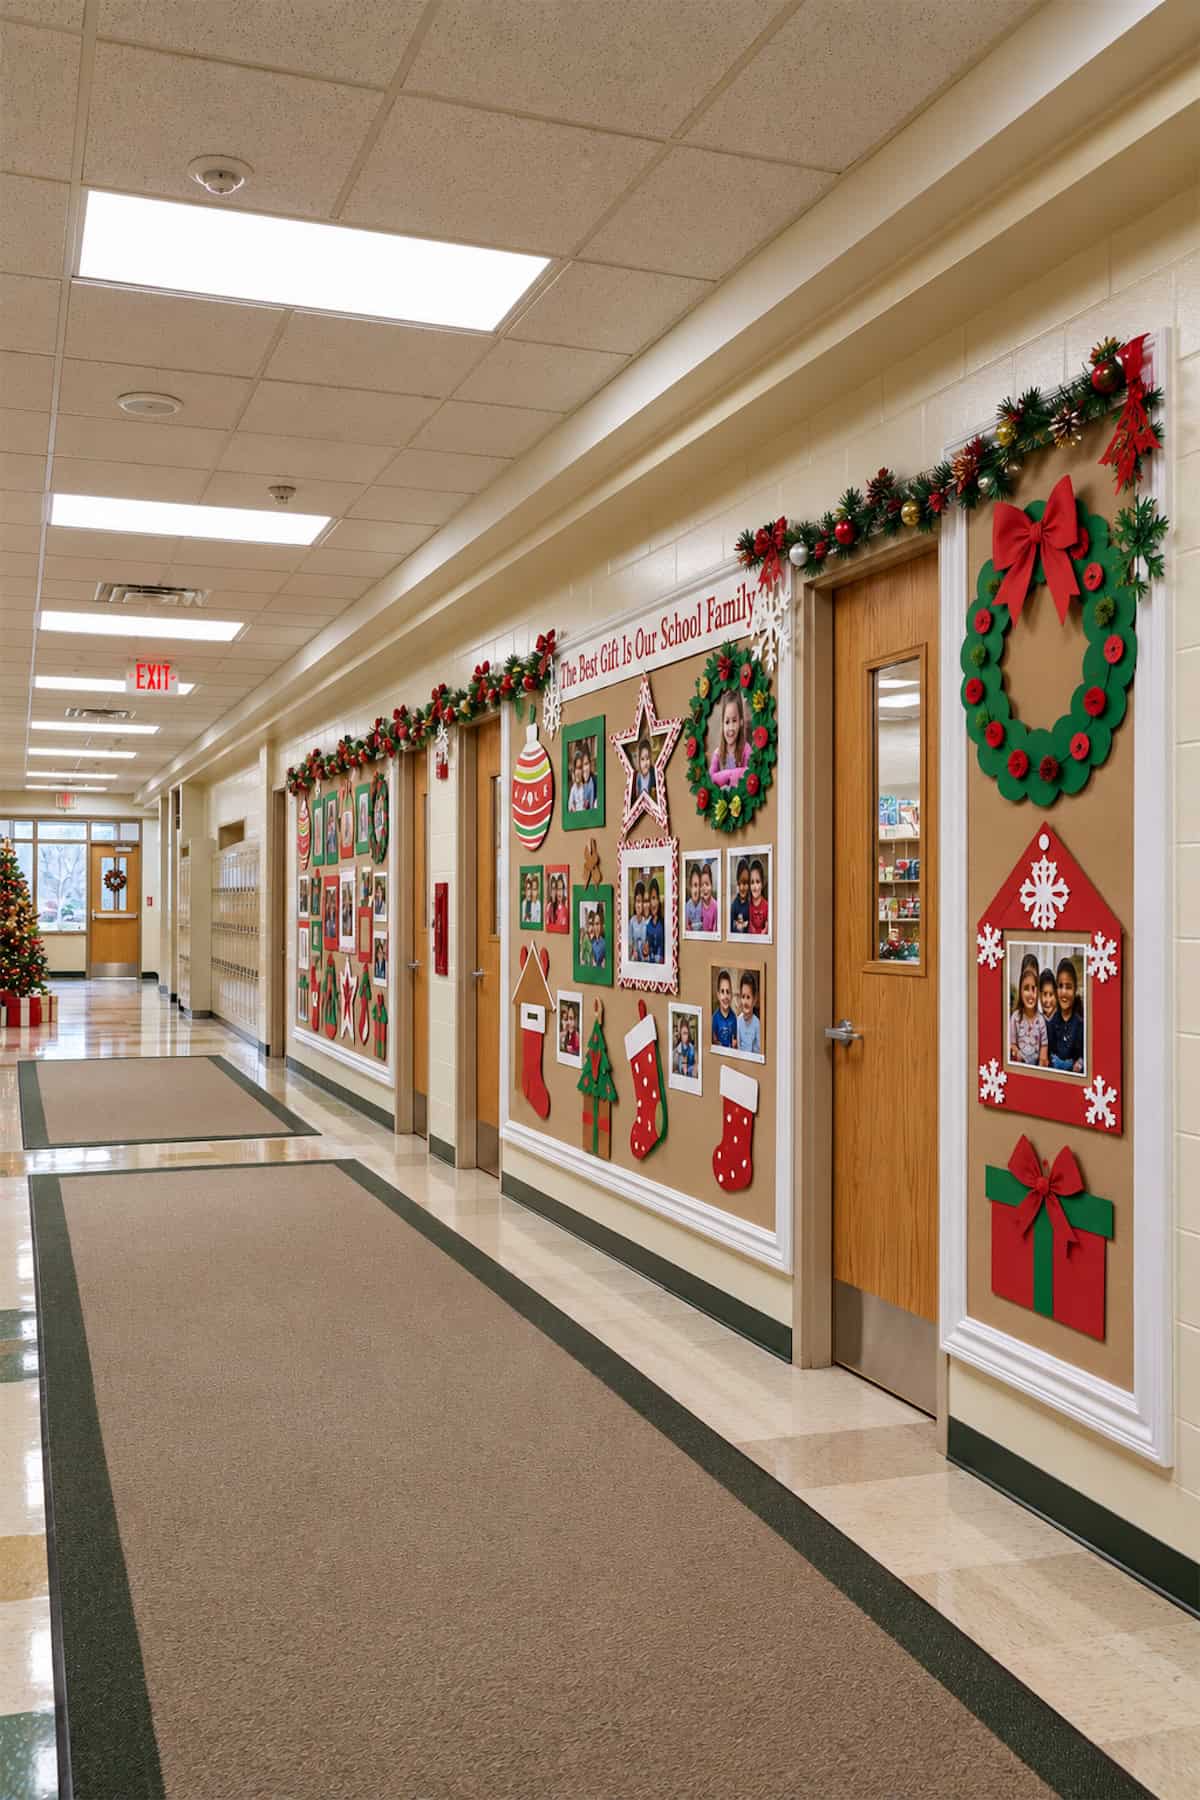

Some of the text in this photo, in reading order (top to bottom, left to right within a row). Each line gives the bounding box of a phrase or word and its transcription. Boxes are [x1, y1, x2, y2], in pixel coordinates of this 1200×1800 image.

[560, 582, 757, 689] The Best Gift Is Our School Family
[136, 663, 170, 690] EXIT
